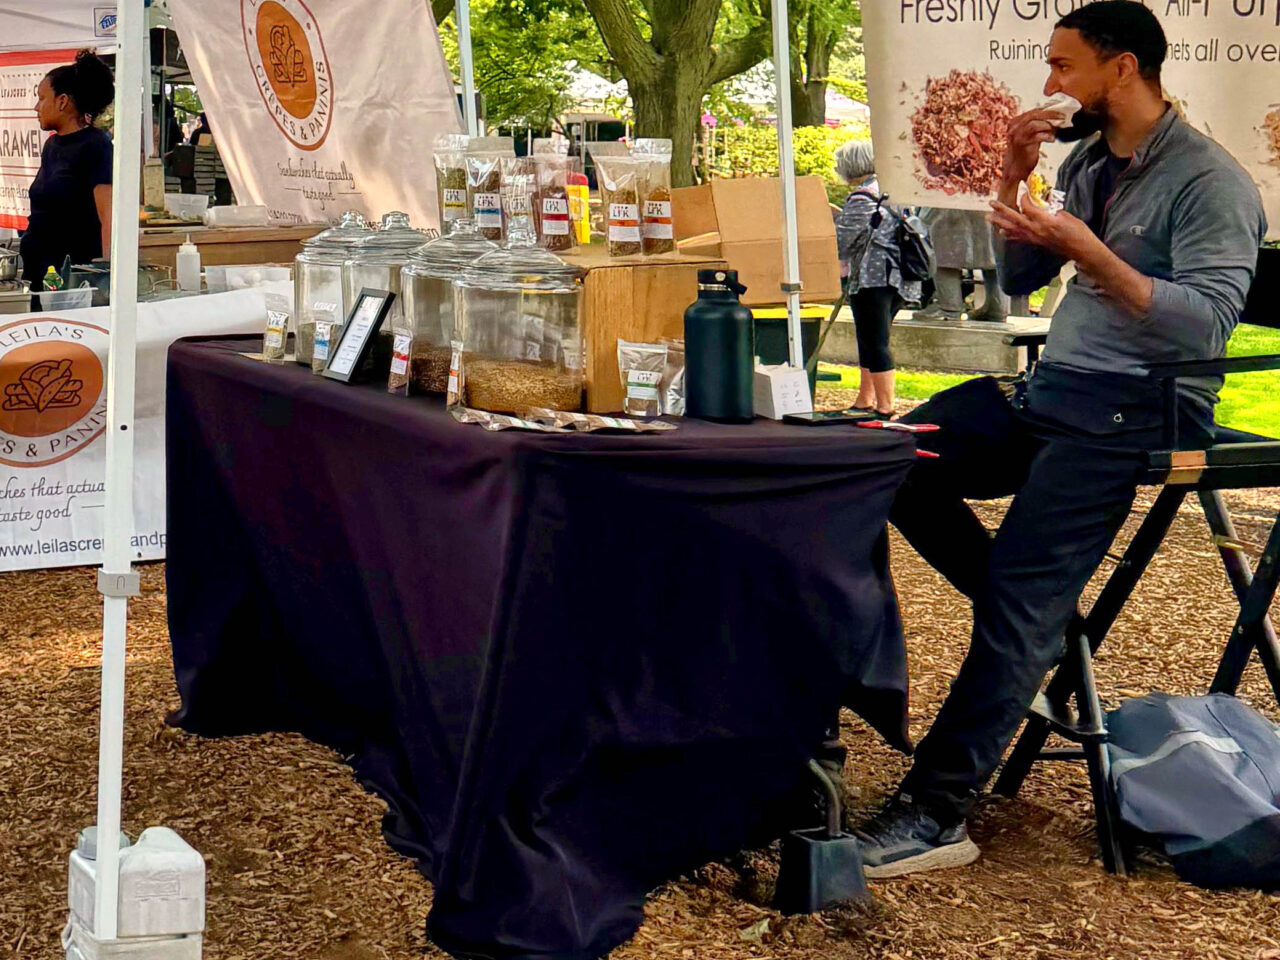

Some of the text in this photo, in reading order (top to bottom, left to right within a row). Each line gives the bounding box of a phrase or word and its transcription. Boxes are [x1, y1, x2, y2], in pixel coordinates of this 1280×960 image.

[1194, 38, 1219, 62] all
[1226, 42, 1280, 63] ove
[25, 443, 38, 458] &
[49, 398, 108, 453] PANIN
[31, 476, 63, 498] that
[30, 495, 78, 532] good
